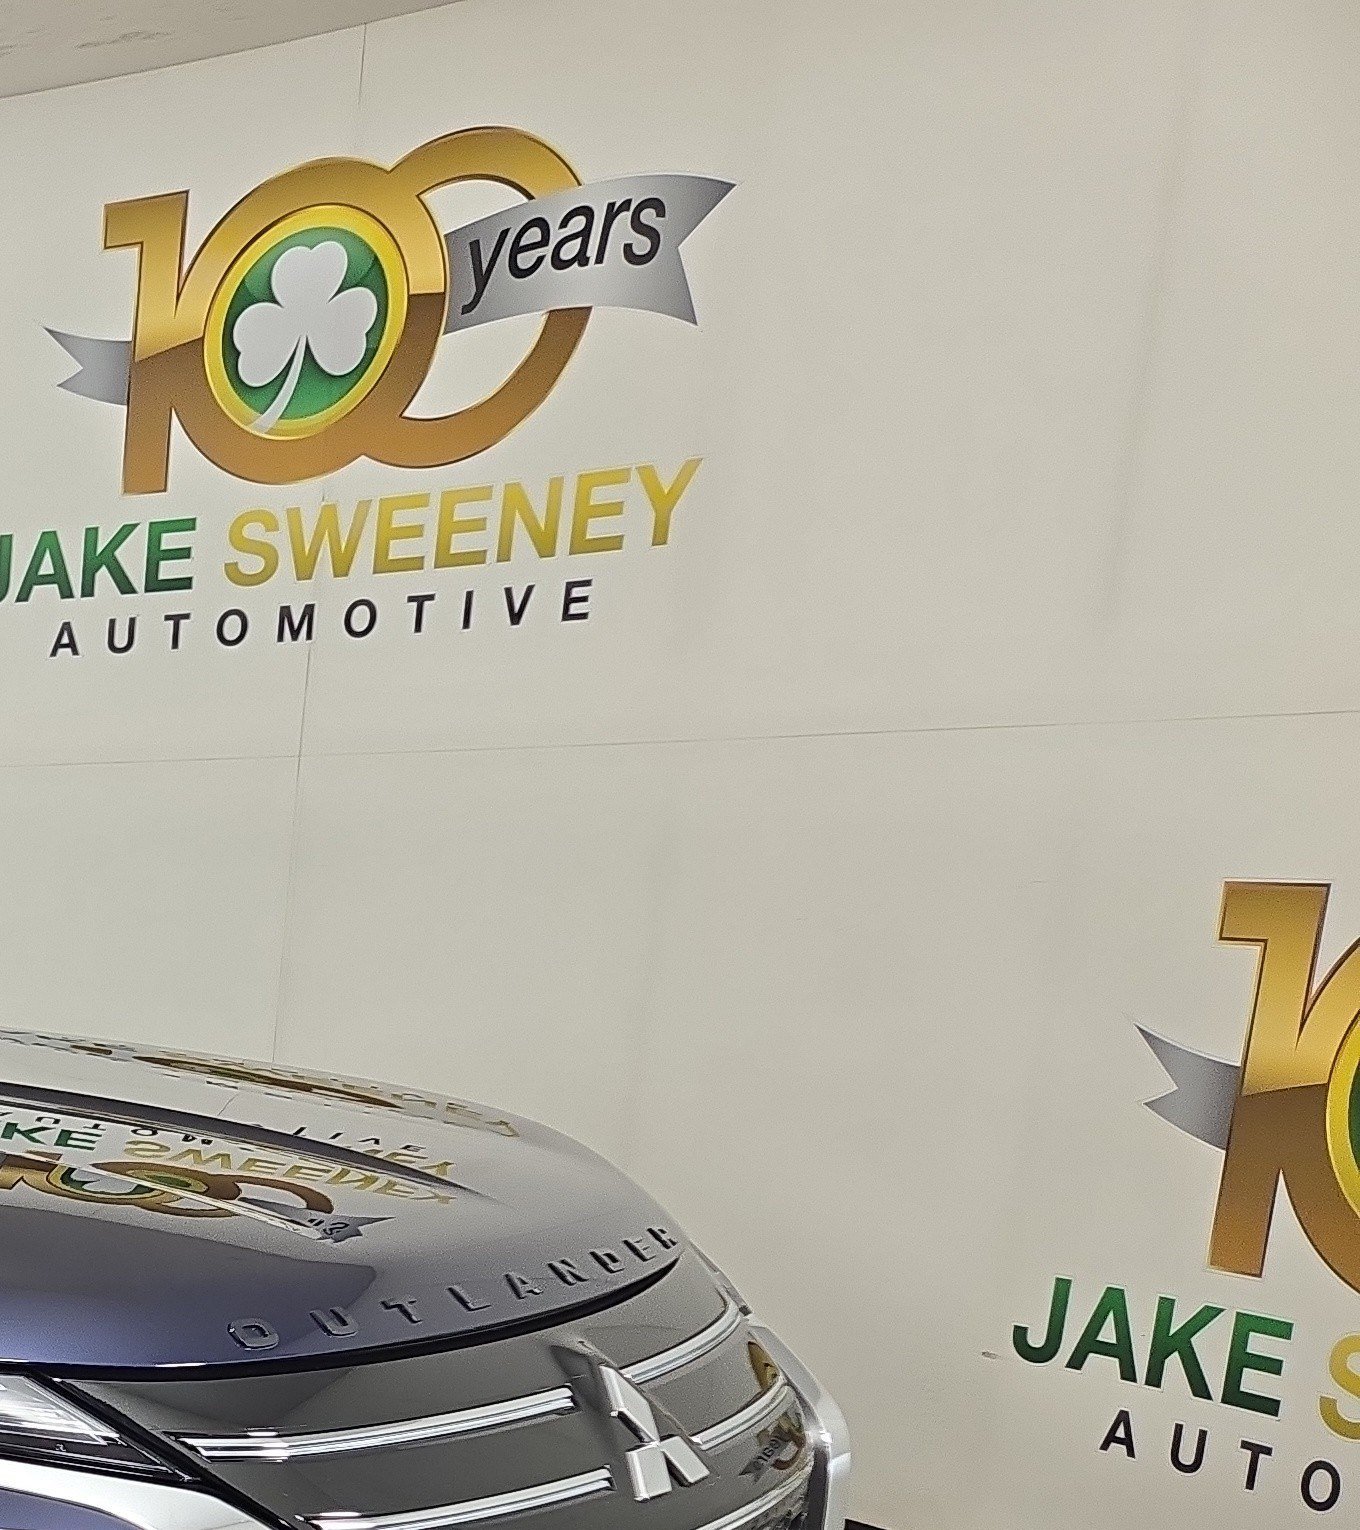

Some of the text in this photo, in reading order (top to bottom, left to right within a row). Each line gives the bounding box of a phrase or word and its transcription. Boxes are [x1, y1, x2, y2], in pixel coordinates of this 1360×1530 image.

[103, 126, 593, 495] 100
[461, 196, 666, 316] years
[224, 458, 704, 588] SWEENEY
[49, 579, 594, 657] AUTOMOTIVE
[227, 1225, 678, 1351] OUTLANDER
[1012, 1276, 1294, 1418] JAKE
[1098, 1408, 1341, 1512] AUTO
